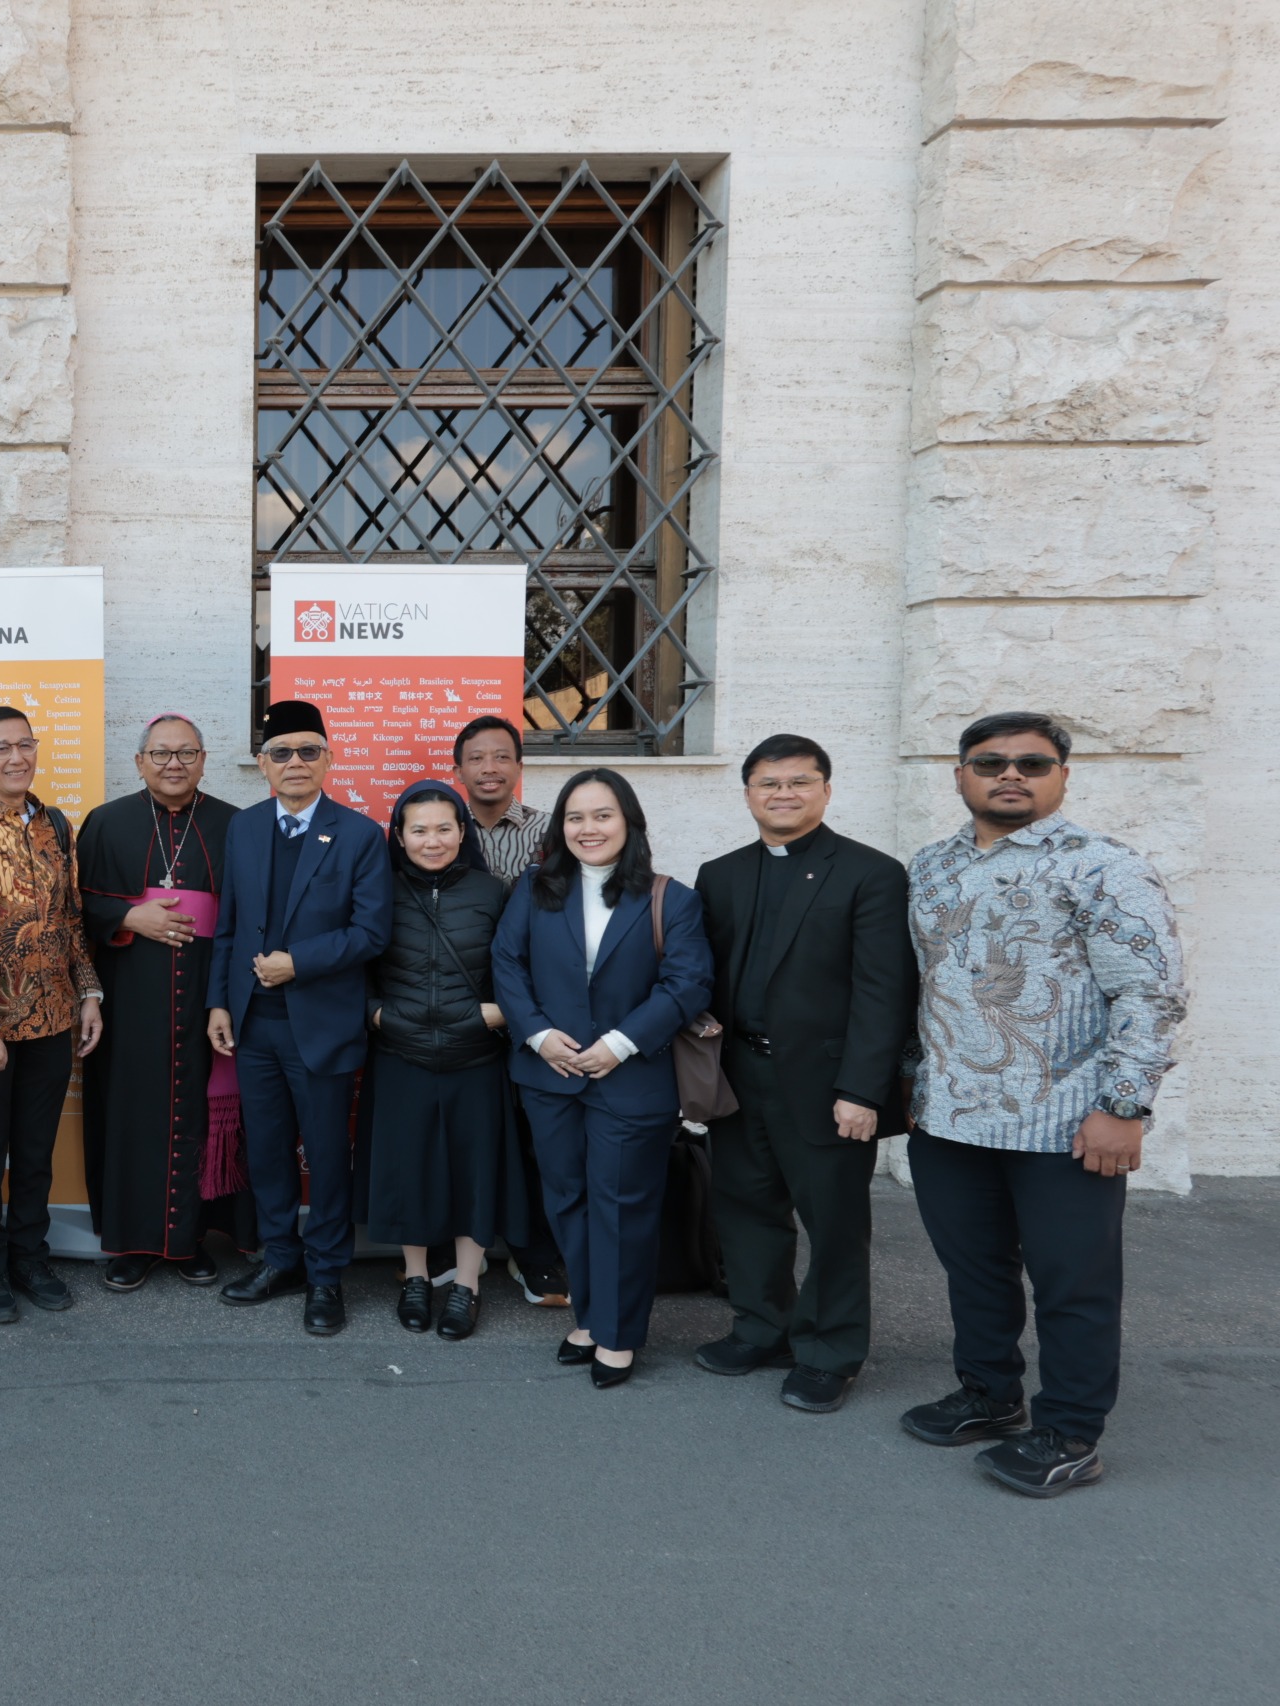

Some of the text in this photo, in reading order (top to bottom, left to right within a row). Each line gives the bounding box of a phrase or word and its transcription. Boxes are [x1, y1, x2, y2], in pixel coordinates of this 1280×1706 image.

[339, 603, 428, 620] VATICAN
[340, 622, 403, 639] NEWS
[40, 682, 80, 690] Беларуская
[295, 678, 315, 687] Shqip
[461, 677, 501, 686] Беларуская
[54, 695, 80, 703] Čeština
[294, 691, 501, 700] Български 繁體中文 简体中文 Čeština
[47, 710, 81, 719] Esperanto
[327, 705, 354, 713] Deutsch
[392, 706, 418, 714] English
[430, 706, 457, 715] Español
[468, 706, 502, 715] Esperanto
[383, 720, 412, 728] Français
[373, 734, 403, 743] Kikongo
[414, 733, 457, 743] Kinyarwand
[344, 747, 368, 757] 한국어
[428, 747, 453, 756] Latvieš
[330, 763, 375, 771] Македонски
[51, 782, 81, 790] Русский
[370, 778, 405, 787] Português
